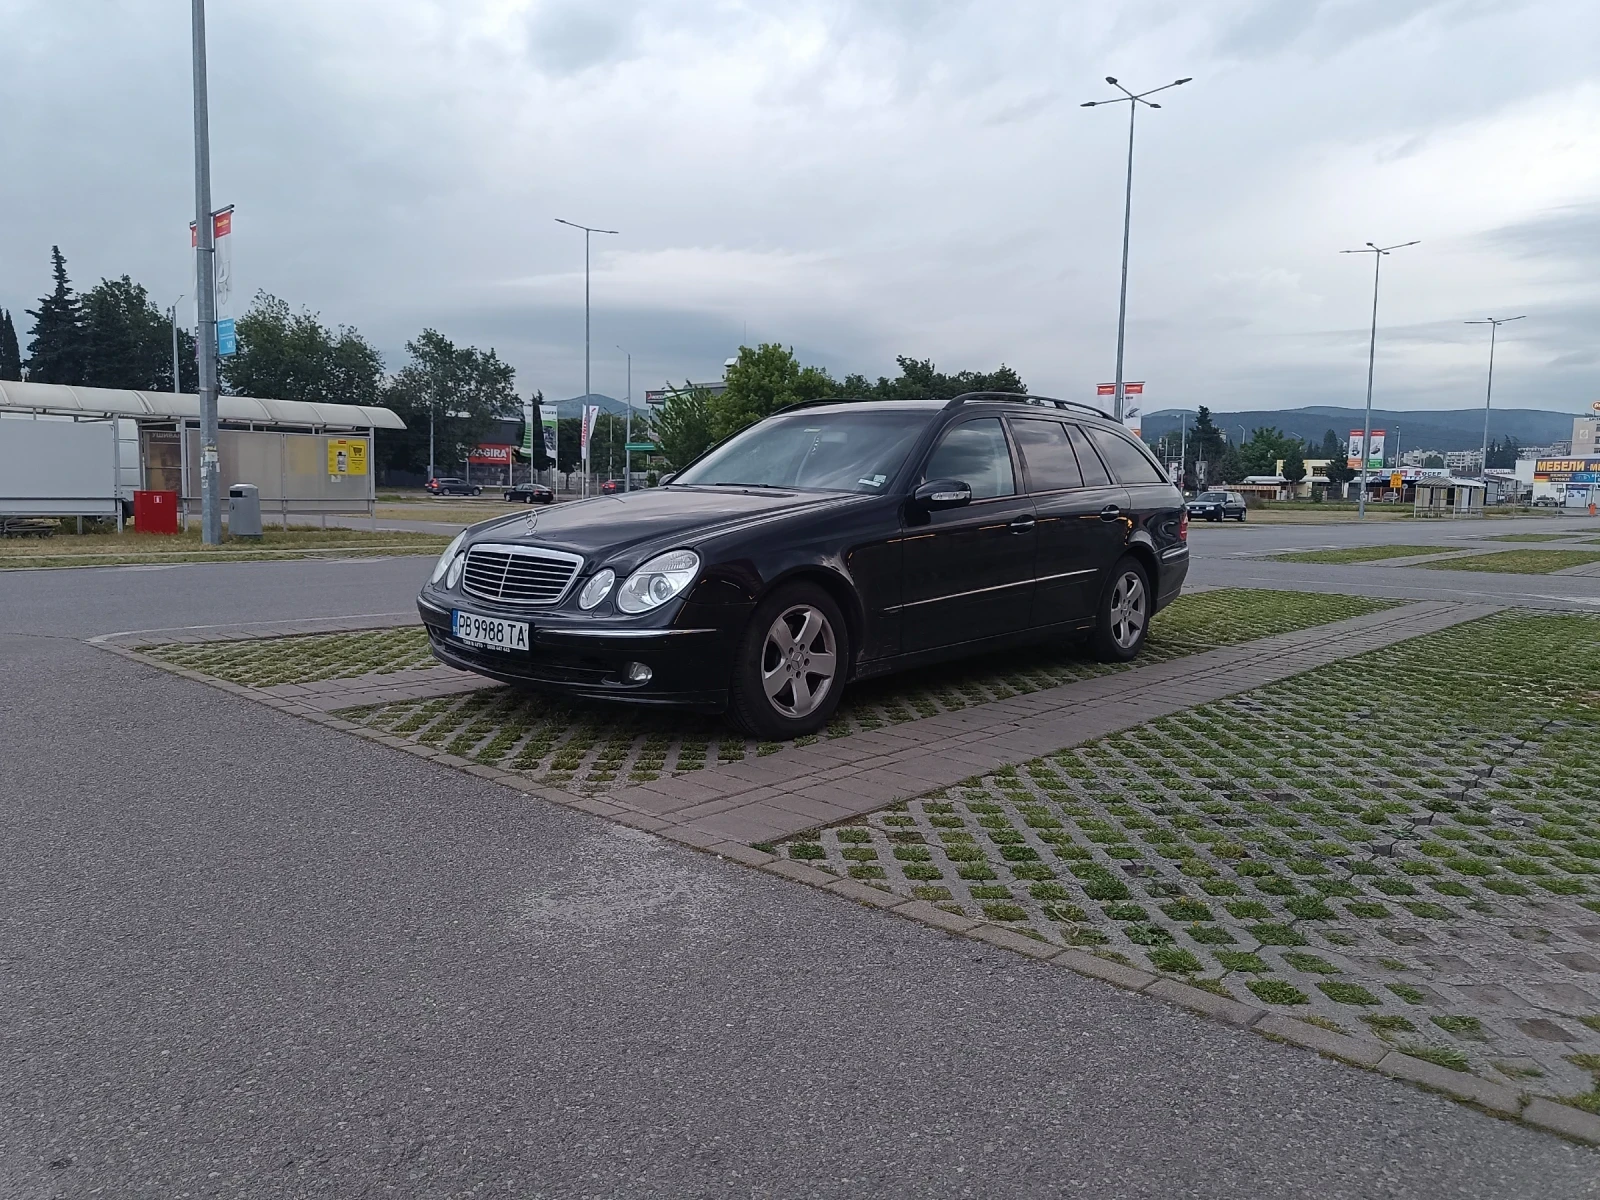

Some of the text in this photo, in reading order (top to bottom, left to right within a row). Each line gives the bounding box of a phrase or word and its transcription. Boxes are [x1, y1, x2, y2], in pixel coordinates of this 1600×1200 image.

[1537, 461, 1585, 471] МЕБЕЛИ
[459, 614, 526, 647] PB 9988 TA
